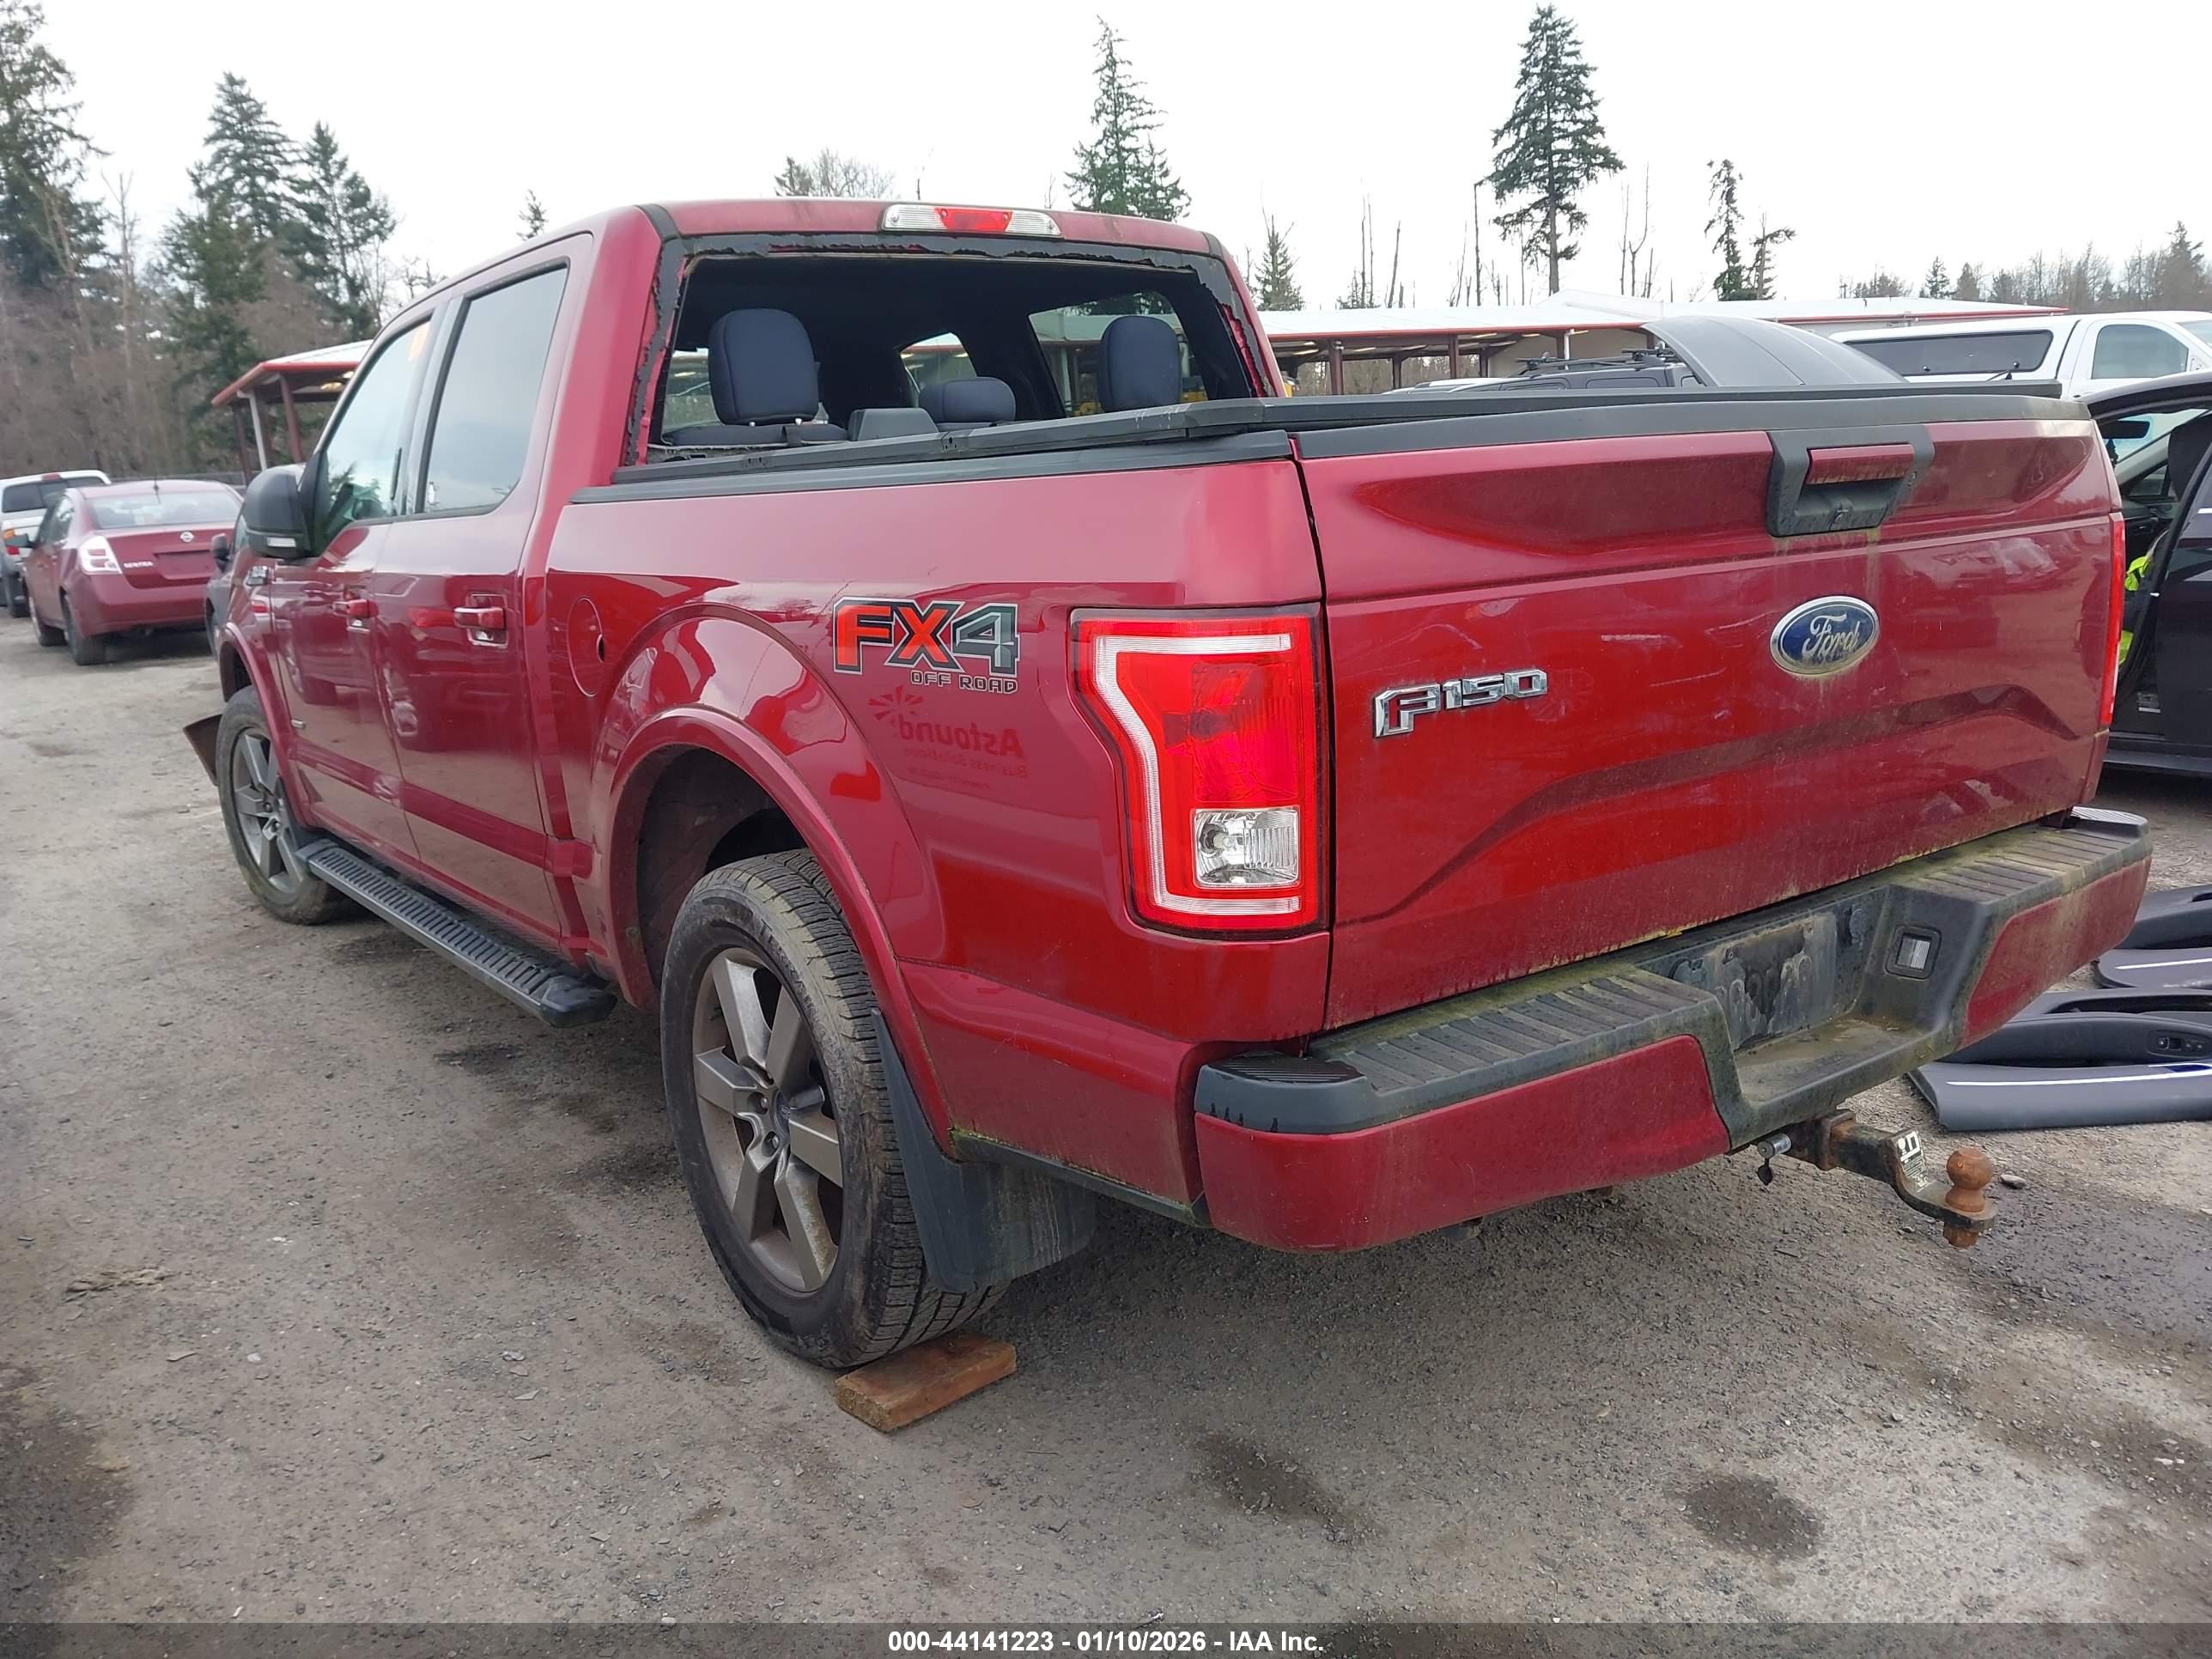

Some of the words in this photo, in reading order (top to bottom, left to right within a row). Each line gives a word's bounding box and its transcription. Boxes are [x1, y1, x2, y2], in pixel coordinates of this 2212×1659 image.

[833, 596, 1021, 678] FX4
[1802, 613, 1860, 662] Ford
[910, 670, 951, 687] OFF
[958, 673, 1018, 694] ROAD
